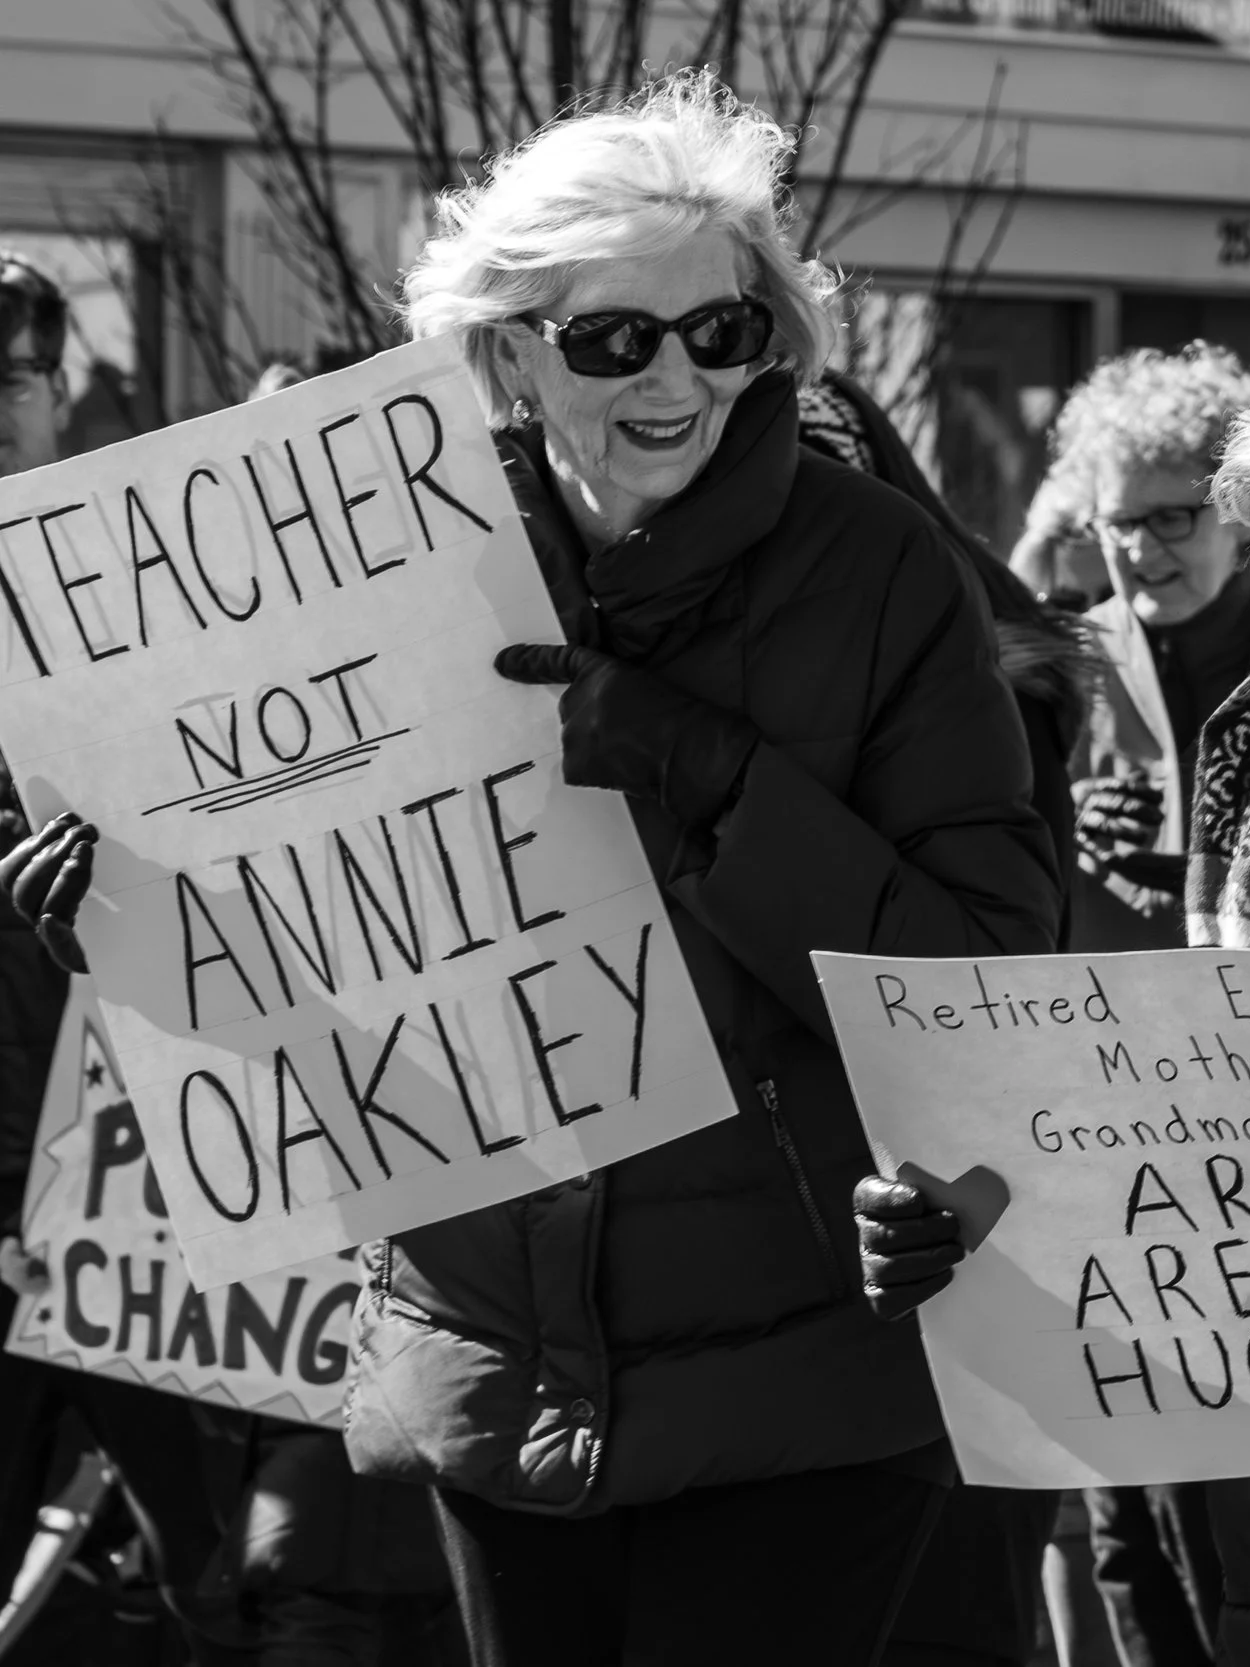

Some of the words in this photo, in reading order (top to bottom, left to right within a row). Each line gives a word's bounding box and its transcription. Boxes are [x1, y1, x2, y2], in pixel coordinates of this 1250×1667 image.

[0, 394, 494, 677] TEACHER
[175, 653, 378, 789] NOT
[176, 760, 567, 1030] ANNIE
[876, 965, 1121, 1032] Retired
[181, 923, 653, 1222] OAKLEY
